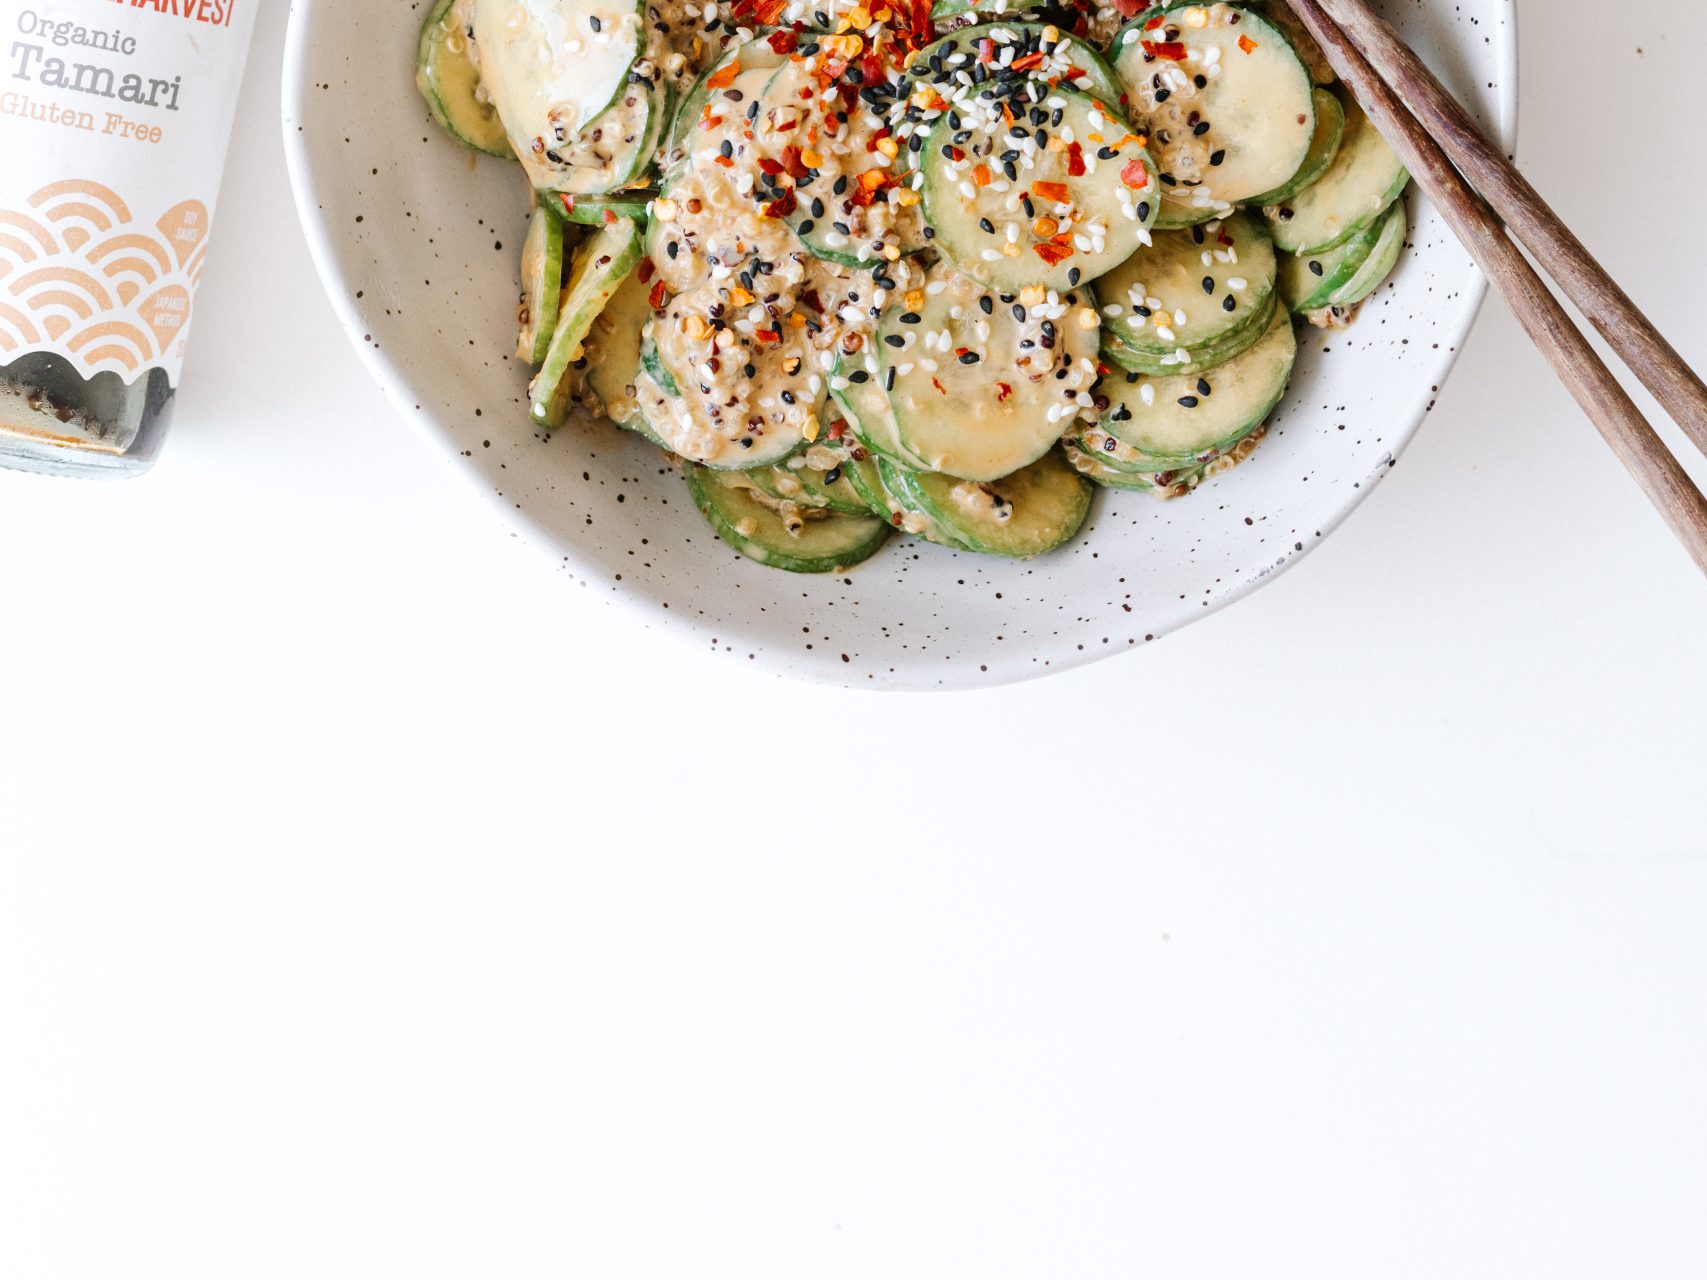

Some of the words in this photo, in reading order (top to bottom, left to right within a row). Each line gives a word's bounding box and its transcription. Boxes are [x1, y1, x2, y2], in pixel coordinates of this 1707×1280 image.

[17, 10, 136, 55] Organic
[11, 41, 182, 111] Tamari
[0, 91, 95, 131] Gluten
[101, 112, 163, 144] Free
